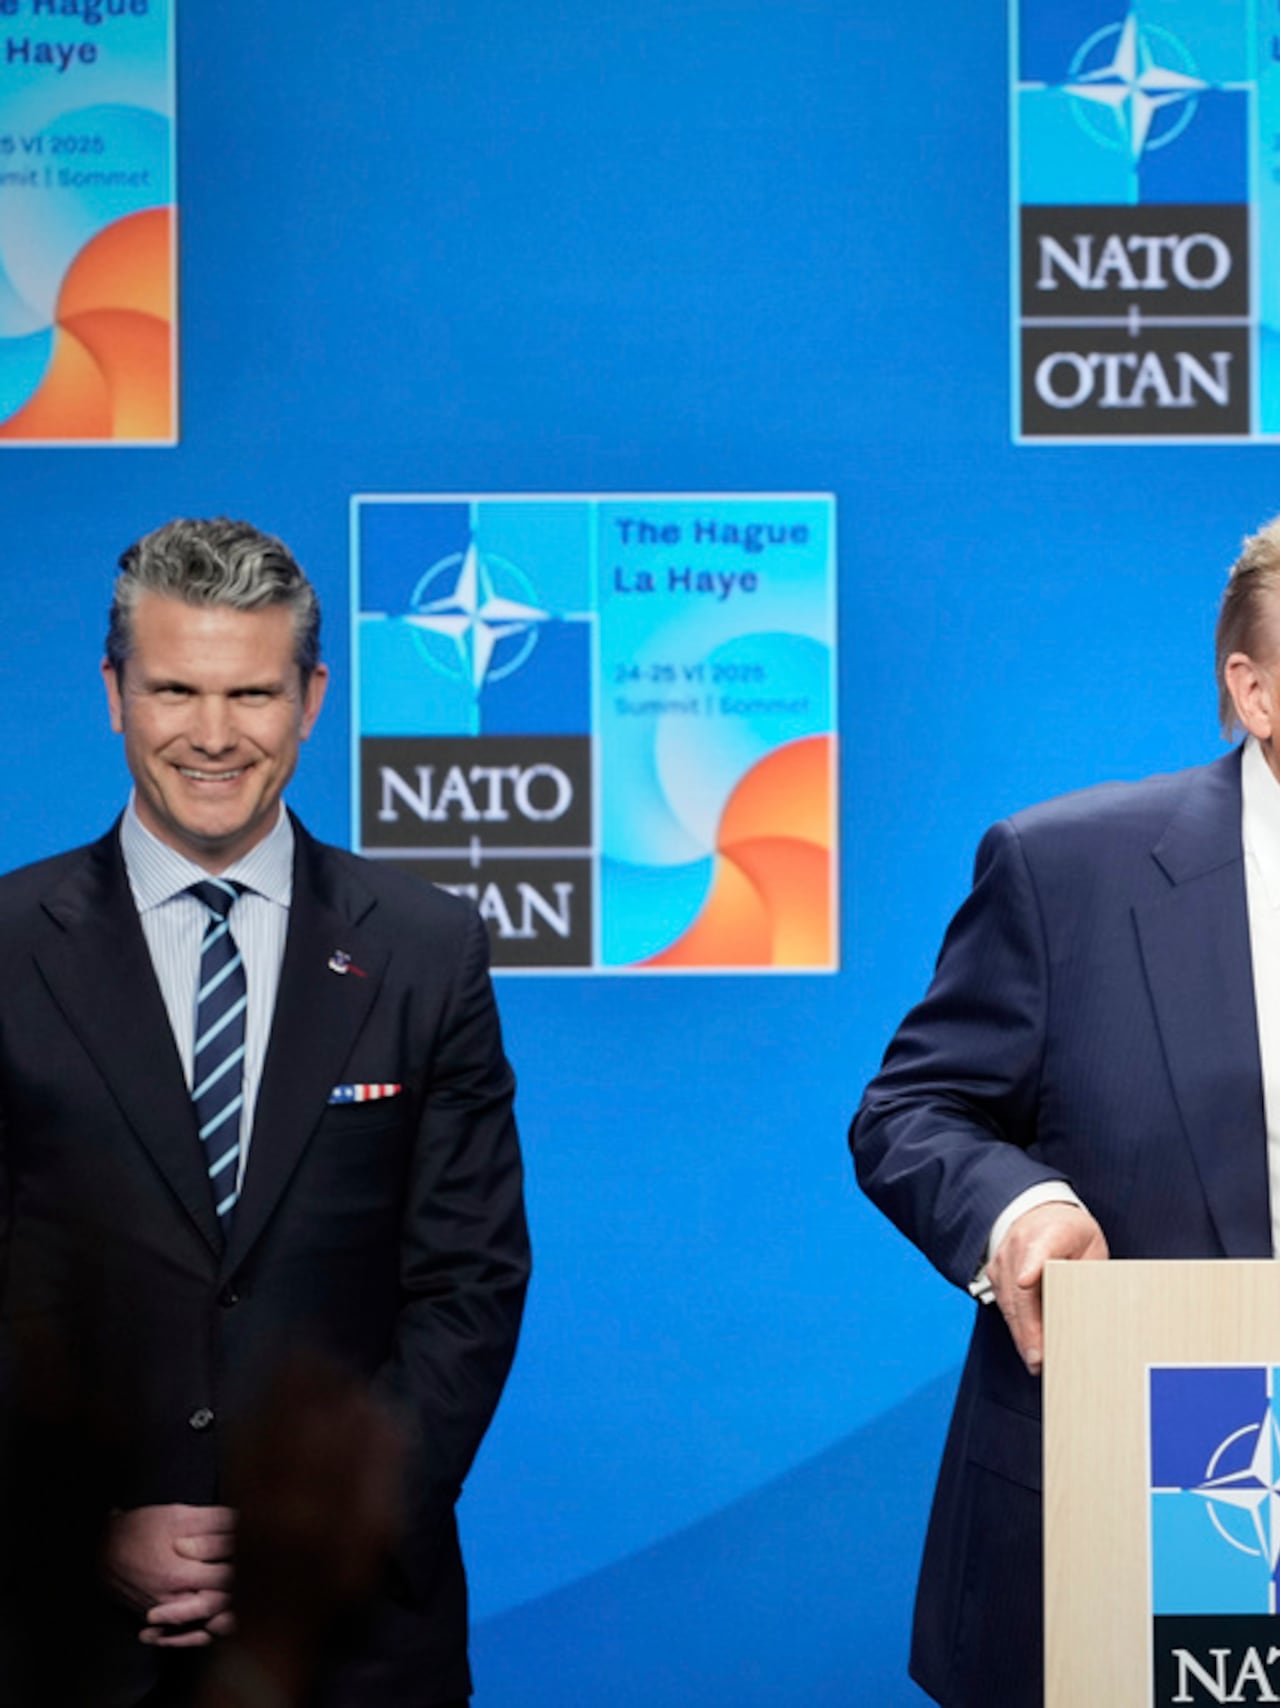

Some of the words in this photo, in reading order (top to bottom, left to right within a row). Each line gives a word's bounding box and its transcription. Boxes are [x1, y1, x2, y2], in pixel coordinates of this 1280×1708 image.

[6, 37, 98, 73] Haye
[51, 135, 105, 154] 2025
[58, 168, 150, 188] Sommet
[1036, 233, 1232, 290] NATO
[1034, 351, 1232, 409] OTAN
[614, 518, 681, 544] The
[694, 518, 809, 554] Hague
[614, 566, 654, 593] La
[668, 566, 758, 602] Haye
[712, 664, 766, 683] 2025
[378, 764, 573, 822] NATO
[432, 881, 574, 939] AN
